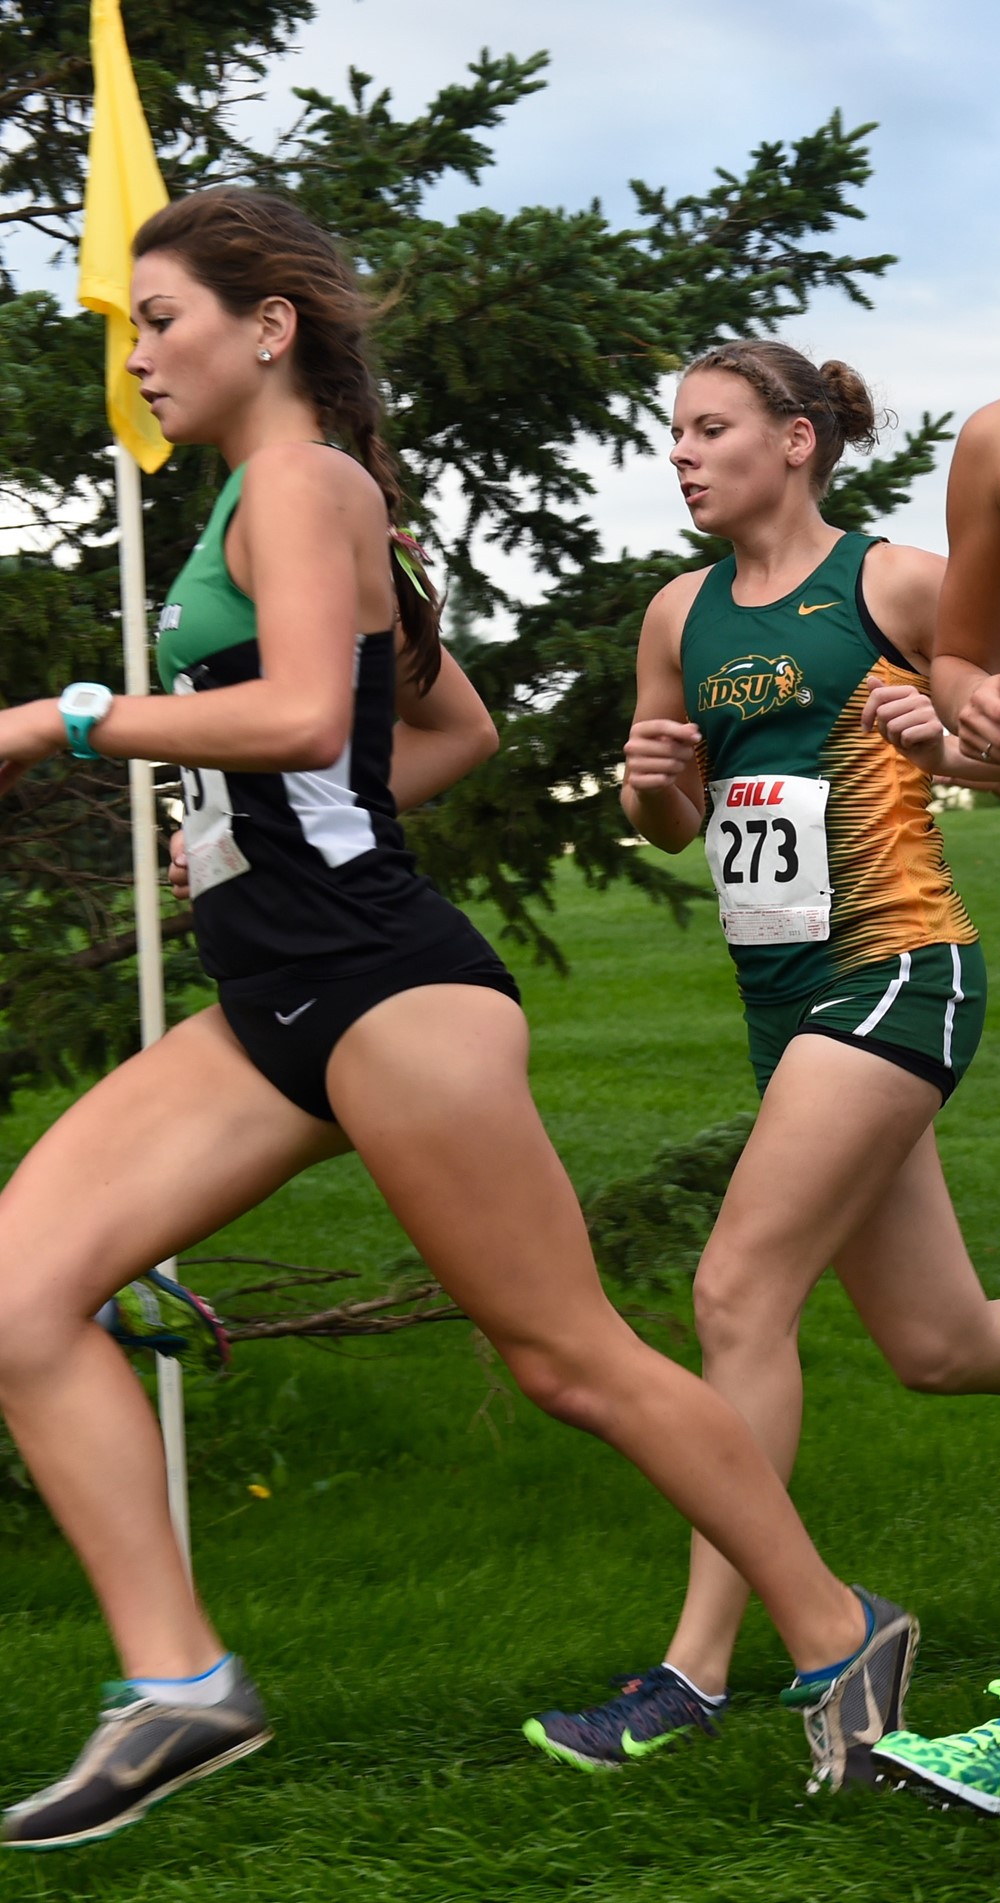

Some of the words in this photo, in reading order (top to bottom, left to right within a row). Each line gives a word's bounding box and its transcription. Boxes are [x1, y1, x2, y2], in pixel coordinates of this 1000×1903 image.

[698, 674, 773, 711] NDSU
[727, 781, 785, 808] GILL
[720, 818, 799, 883] 273
